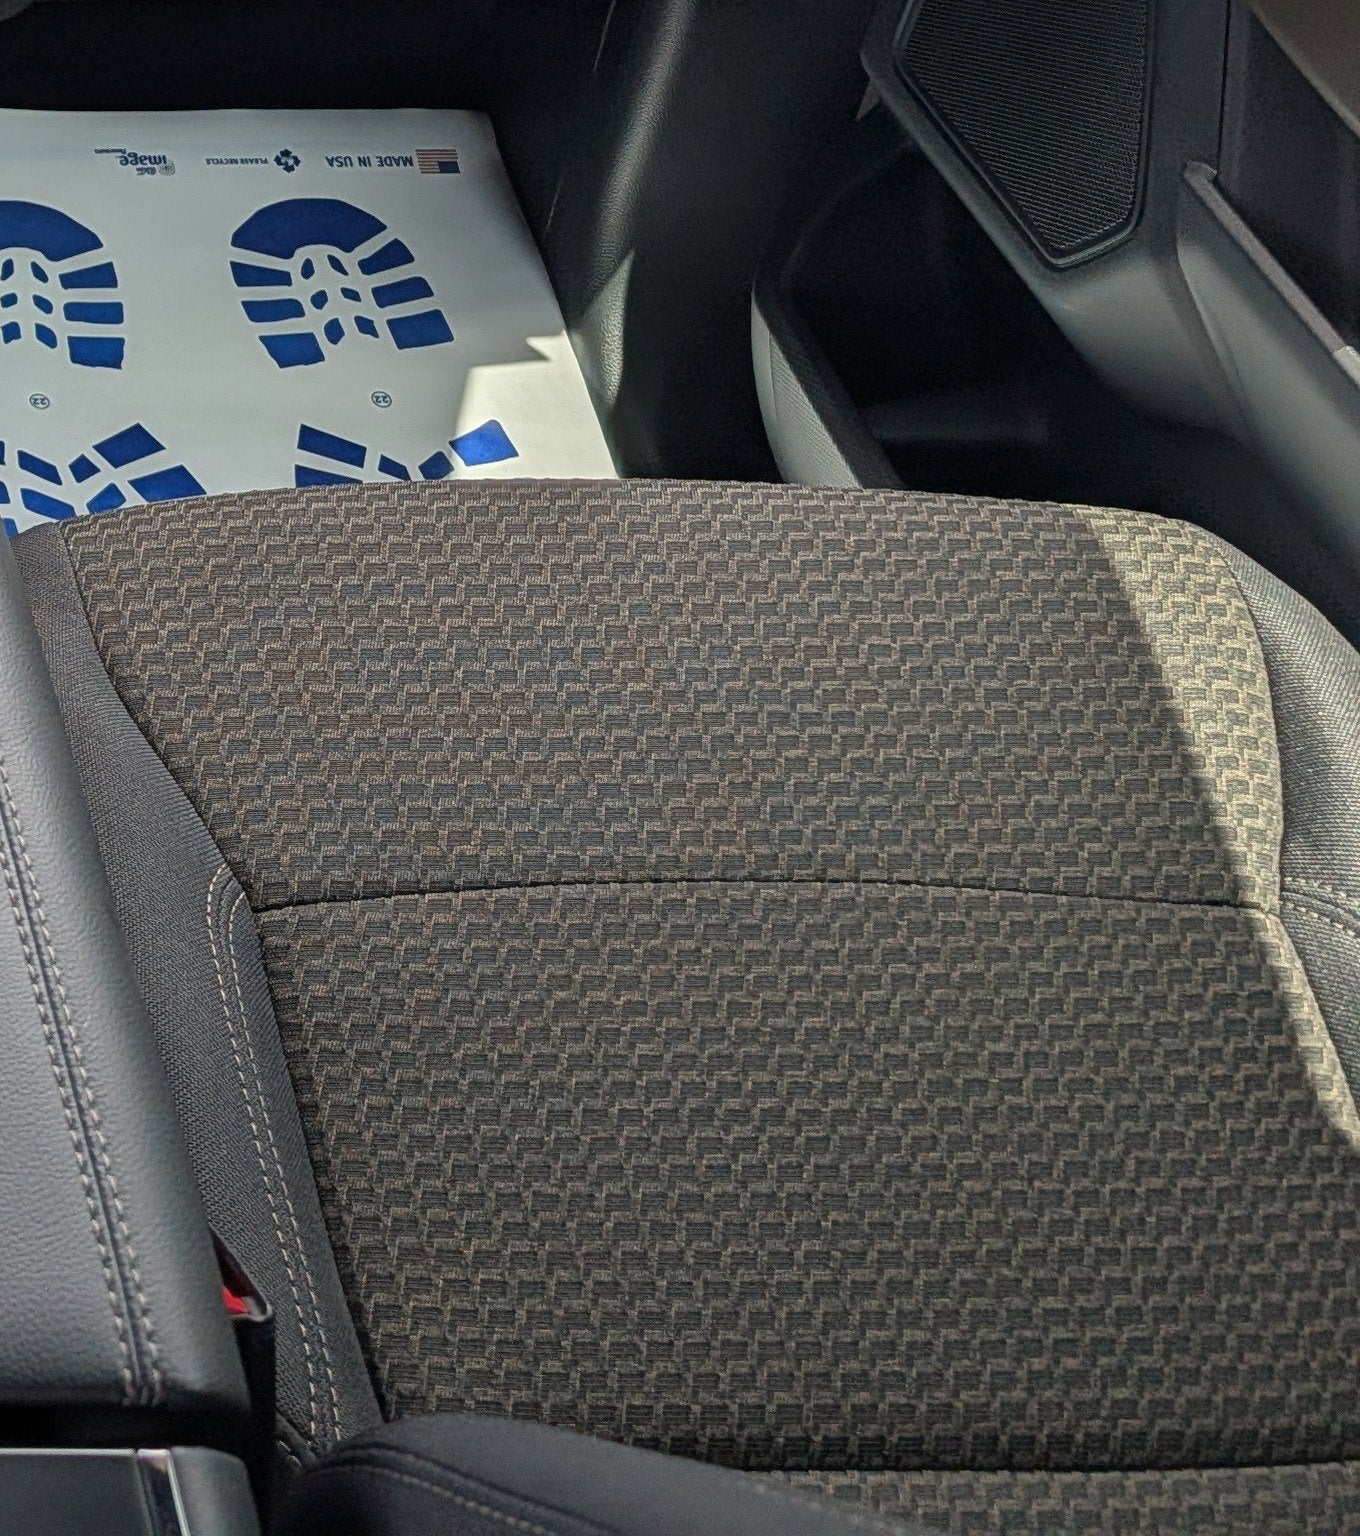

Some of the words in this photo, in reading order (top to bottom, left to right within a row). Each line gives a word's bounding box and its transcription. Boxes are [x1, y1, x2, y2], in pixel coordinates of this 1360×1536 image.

[119, 152, 167, 167] image
[325, 155, 353, 168] USA
[358, 156, 371, 168] IN
[376, 155, 414, 168] MADE
